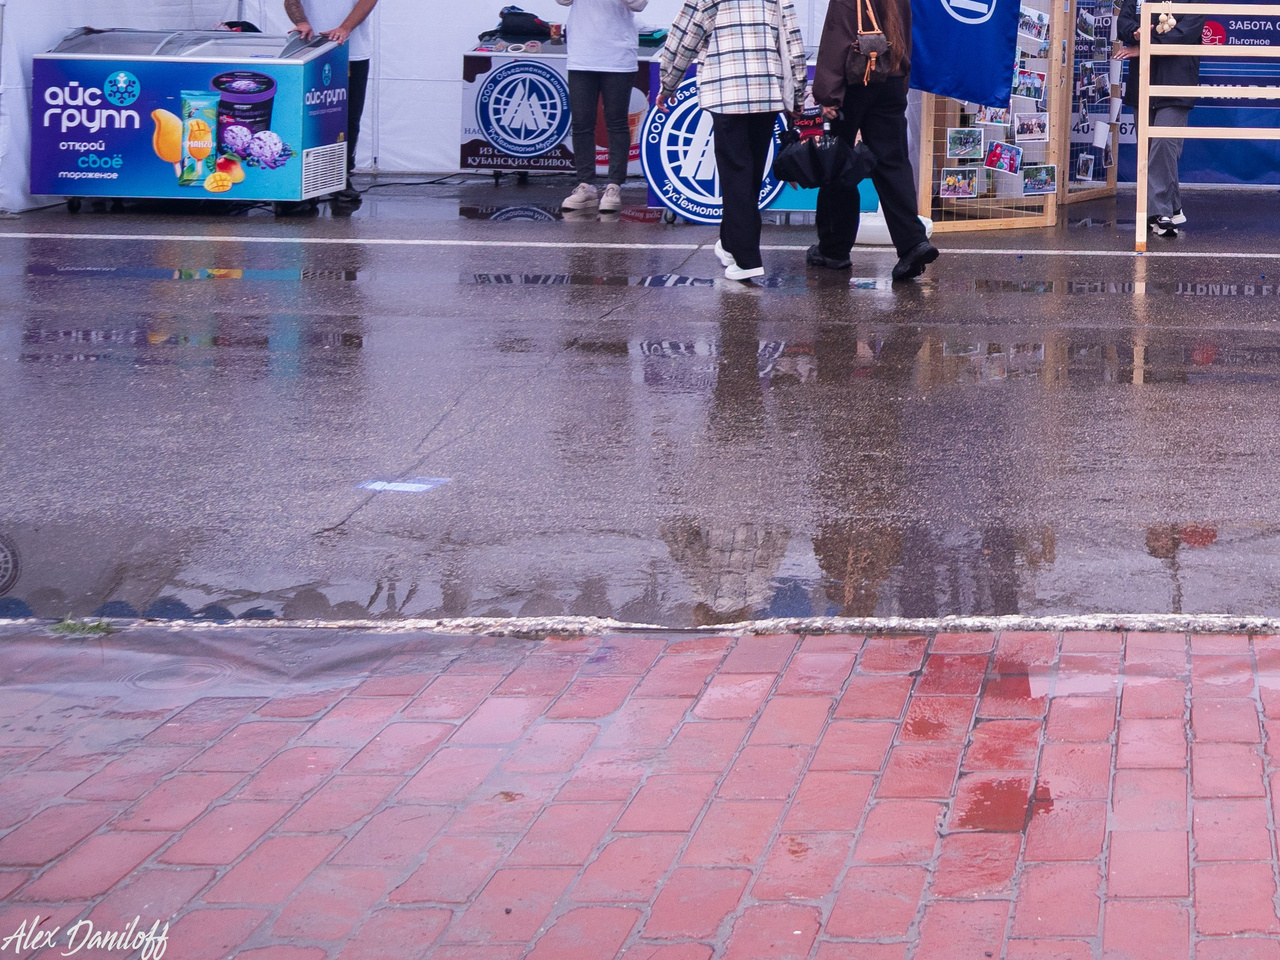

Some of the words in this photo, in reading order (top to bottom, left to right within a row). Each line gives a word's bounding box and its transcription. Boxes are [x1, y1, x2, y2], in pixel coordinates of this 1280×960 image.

[1229, 20, 1273, 31] ЗАБОТА
[1229, 36, 1271, 46] Льготное
[44, 81, 103, 106] айс
[482, 83, 495, 103] ООО
[43, 108, 140, 133] групп
[649, 113, 665, 144] ООО
[59, 140, 106, 152] открой
[78, 153, 123, 168] своё
[467, 156, 529, 167] КУБАНСКИХ
[530, 158, 576, 168] СЛИВОК
[58, 171, 119, 180] мороженое
